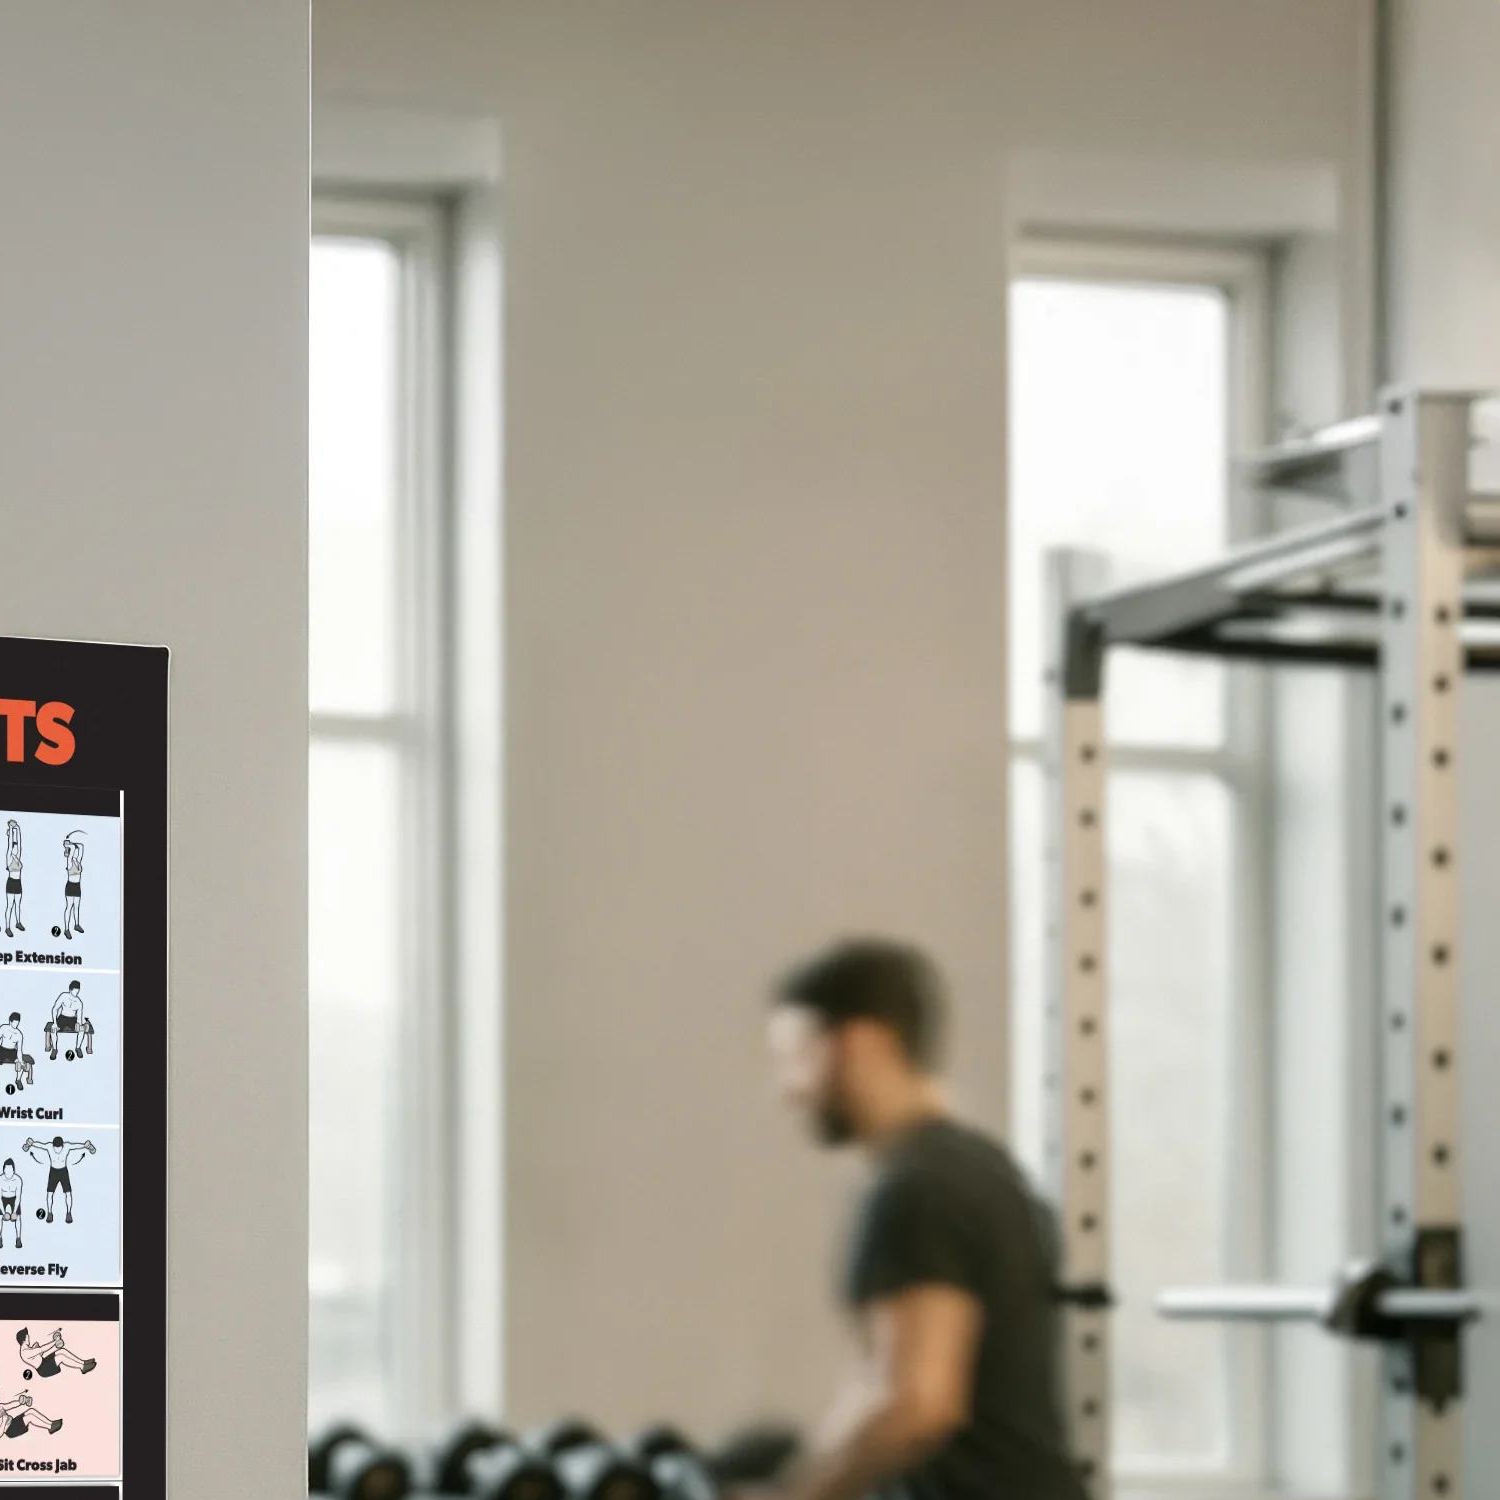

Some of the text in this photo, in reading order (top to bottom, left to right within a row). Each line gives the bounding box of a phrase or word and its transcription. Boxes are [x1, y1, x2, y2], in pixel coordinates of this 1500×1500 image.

[15, 950, 82, 965] Extension
[35, 1107, 63, 1120] Curl
[48, 1263, 68, 1278] Fly
[16, 1459, 53, 1471] Cross
[54, 1459, 77, 1474] Jab
